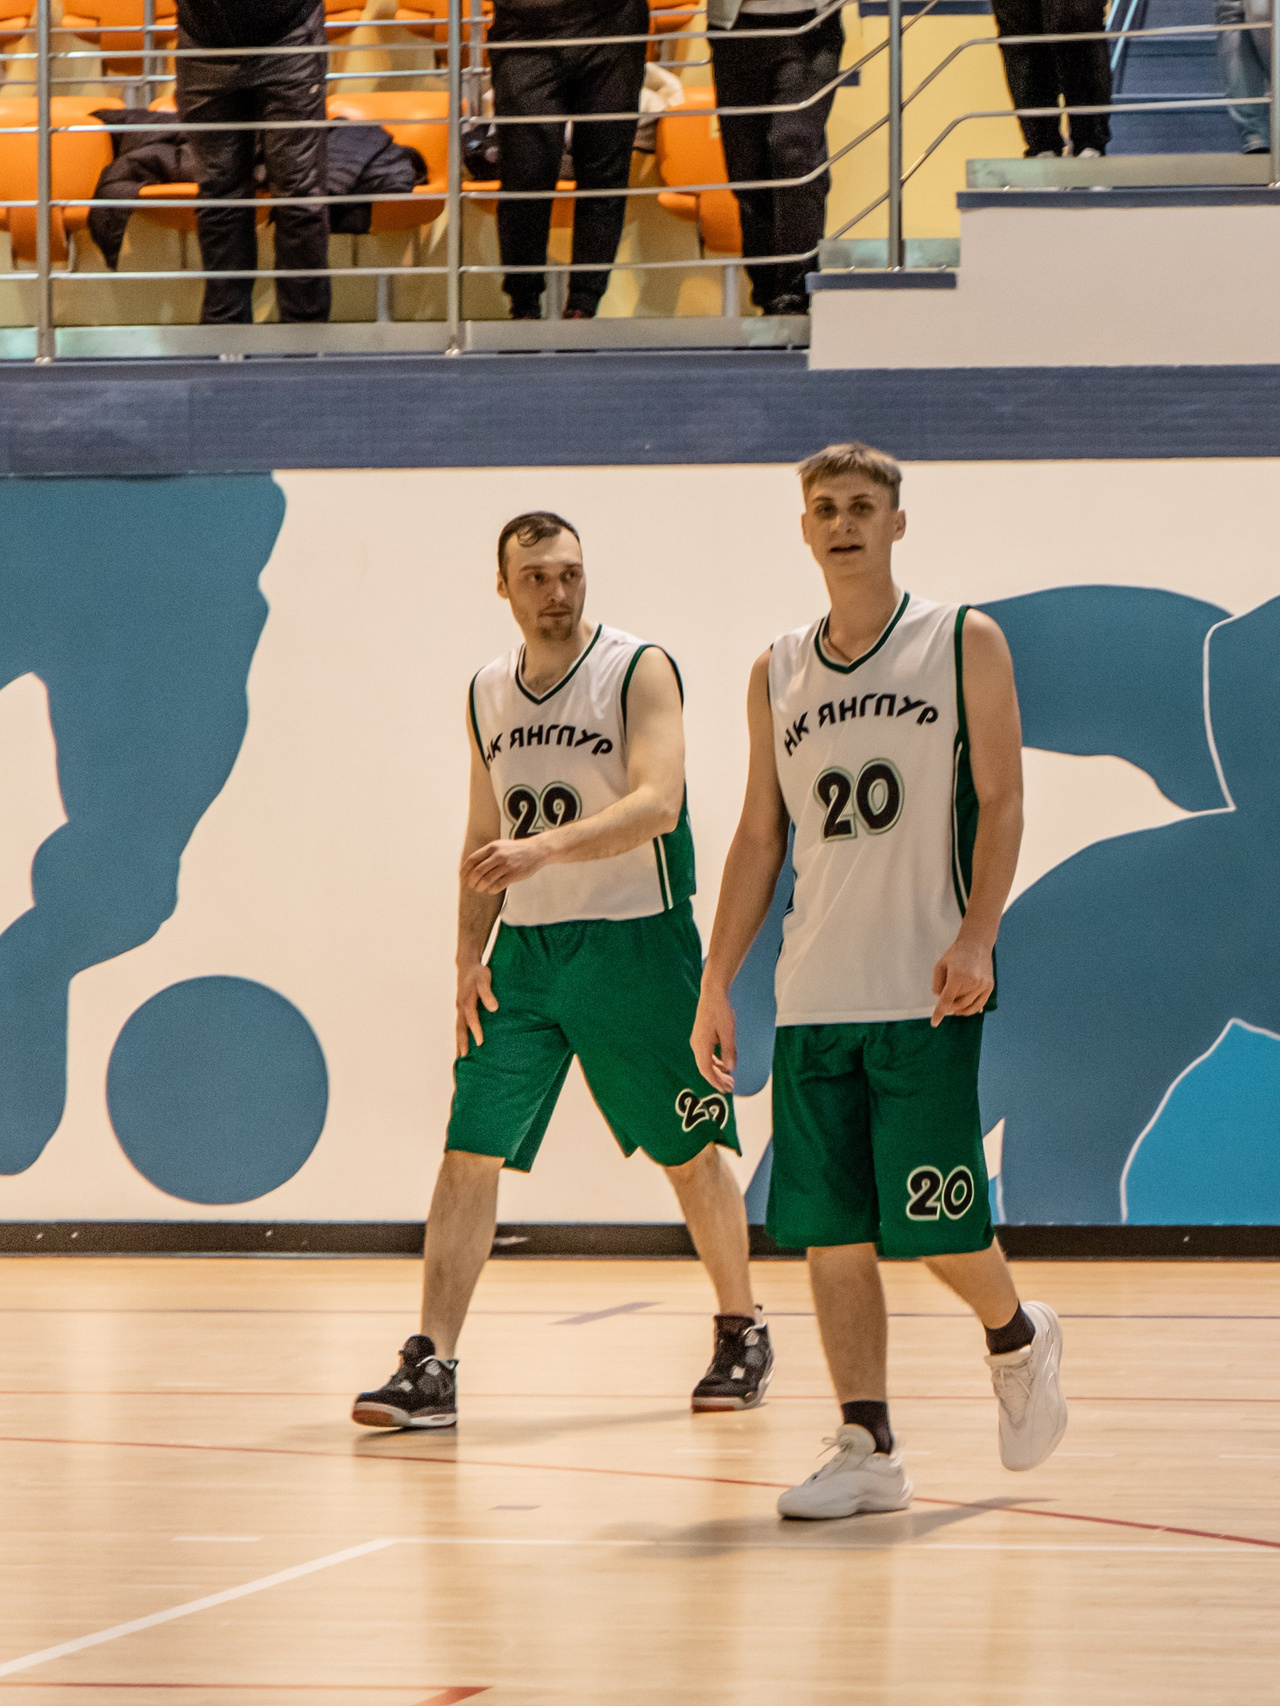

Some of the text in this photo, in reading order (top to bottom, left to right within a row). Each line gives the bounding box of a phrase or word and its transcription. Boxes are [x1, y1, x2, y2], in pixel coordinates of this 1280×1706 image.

[485, 723, 613, 764] НК ЯНГПУР
[784, 693, 939, 757] НК ЯНГПУР
[503, 781, 582, 841] 29
[813, 757, 905, 842] 20
[906, 1165, 975, 1221] 20
